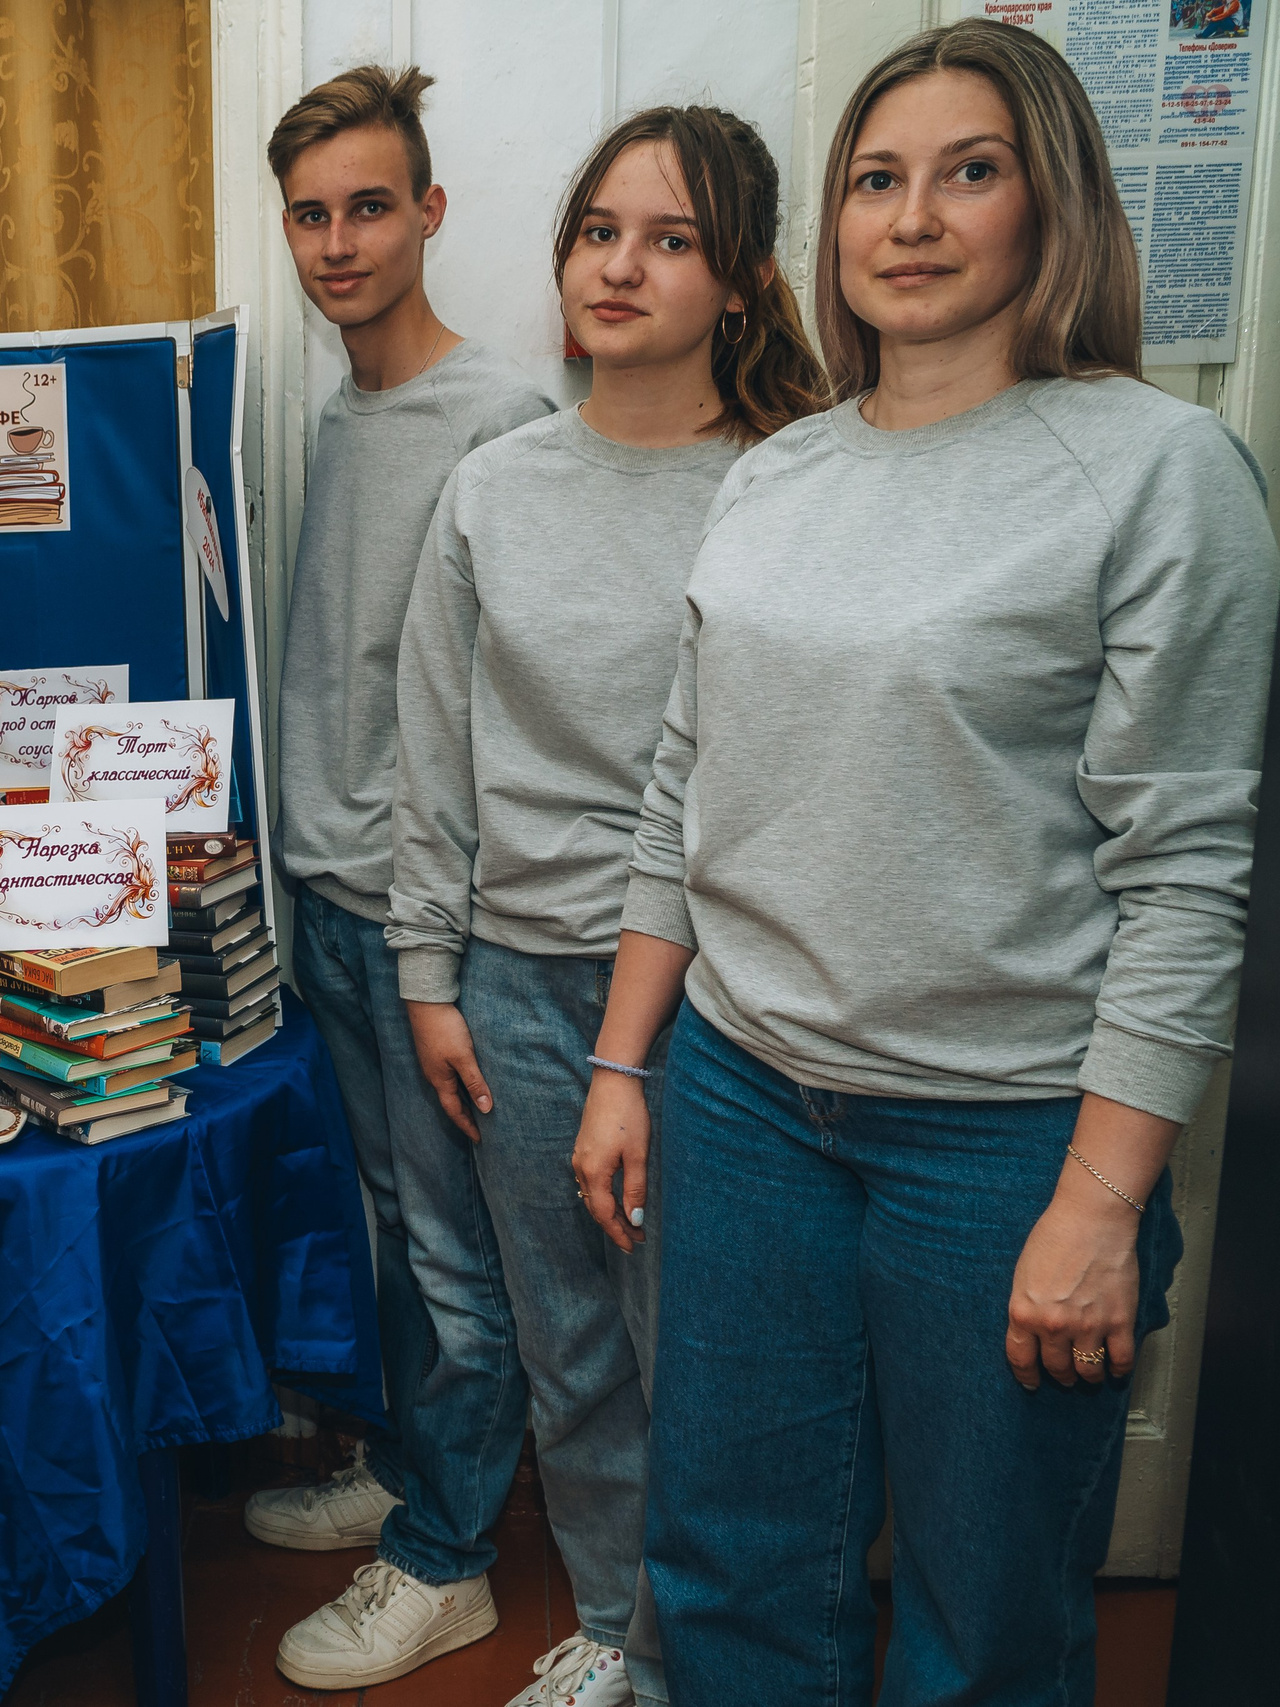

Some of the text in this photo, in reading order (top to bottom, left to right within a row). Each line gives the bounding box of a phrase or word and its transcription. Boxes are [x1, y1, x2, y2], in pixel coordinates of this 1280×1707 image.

[985, 3, 1036, 15] Краснодарского
[1037, 2, 1052, 13] края
[1179, 43, 1207, 53] Телефоны
[33, 373, 57, 387] 12+
[1, 717, 26, 735] под
[117, 735, 167, 758] Торт
[89, 766, 192, 782] классический
[17, 838, 100, 862] Нарезка
[24, 965, 54, 985] ЧАС БЫКА
